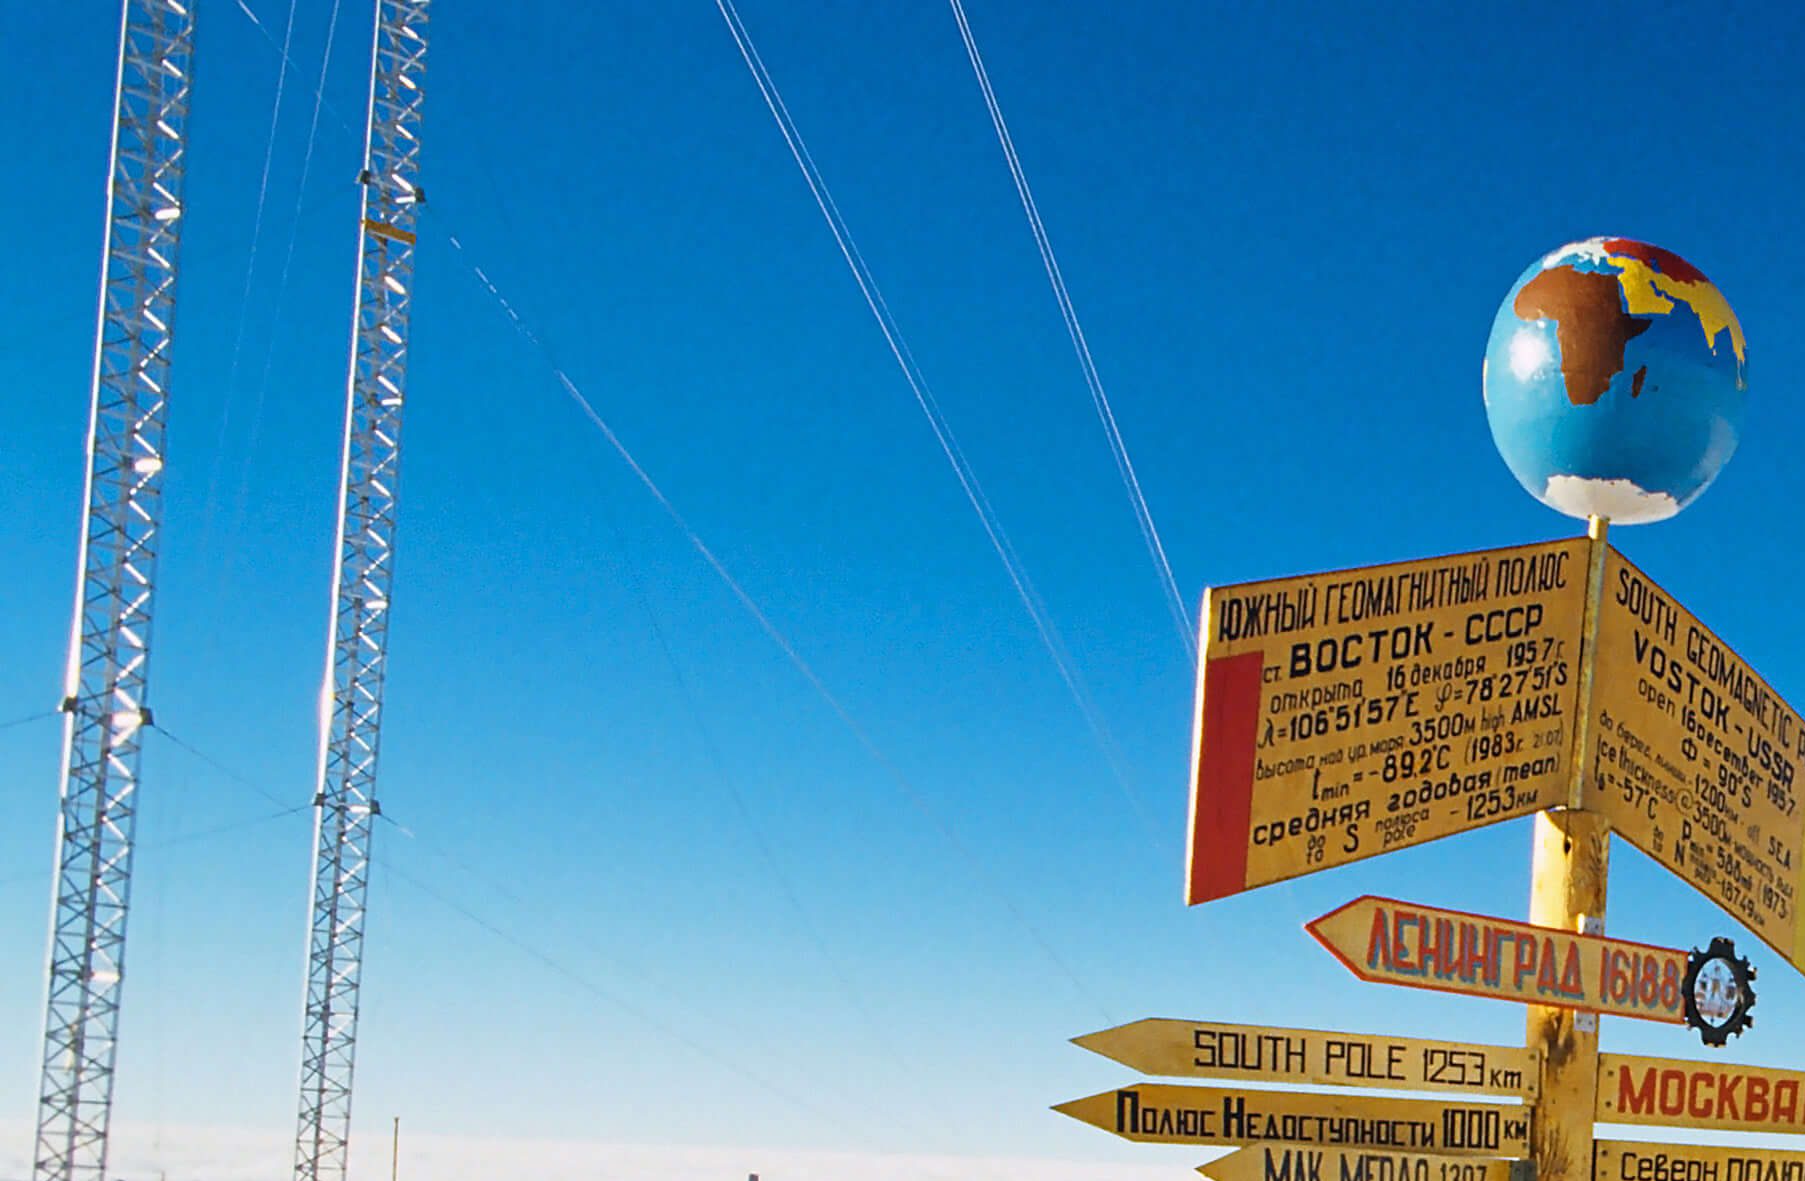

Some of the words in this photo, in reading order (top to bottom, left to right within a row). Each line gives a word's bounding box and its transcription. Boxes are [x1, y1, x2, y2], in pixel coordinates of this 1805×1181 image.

[1218, 582, 1317, 642] ЮЖНЫЙ
[1324, 556, 1491, 626] ГЕОМАГНИТНЫЙ
[1495, 551, 1570, 598] ПОЛЮС
[1289, 621, 1435, 679] ВОСТОК
[1464, 603, 1544, 646] СССР
[1615, 567, 1678, 646] SOUTH
[1686, 625, 1793, 749] GEOMAGNETIC
[1270, 677, 1364, 714] открыта
[1386, 664, 1406, 692] 16
[1410, 655, 1486, 687] декабря
[1510, 693, 1563, 726] AMSL
[1633, 628, 1730, 734] VOSTOK
[1747, 726, 1795, 793] USSR
[1637, 677, 1676, 718] open
[1252, 799, 1371, 847] средняя
[1386, 769, 1492, 813] годовая
[1342, 822, 1360, 853] S
[1382, 824, 1416, 849] pole
[1366, 906, 1585, 1000] ЛЕНИНГРАД
[1600, 945, 1682, 1012] 16188
[1193, 1029, 1306, 1074] SOUTH
[1325, 1039, 1407, 1081] POLE
[1422, 1047, 1486, 1087] 1253
[1616, 1064, 1800, 1124] МОСКВА
[1441, 1108, 1501, 1150] 1000
